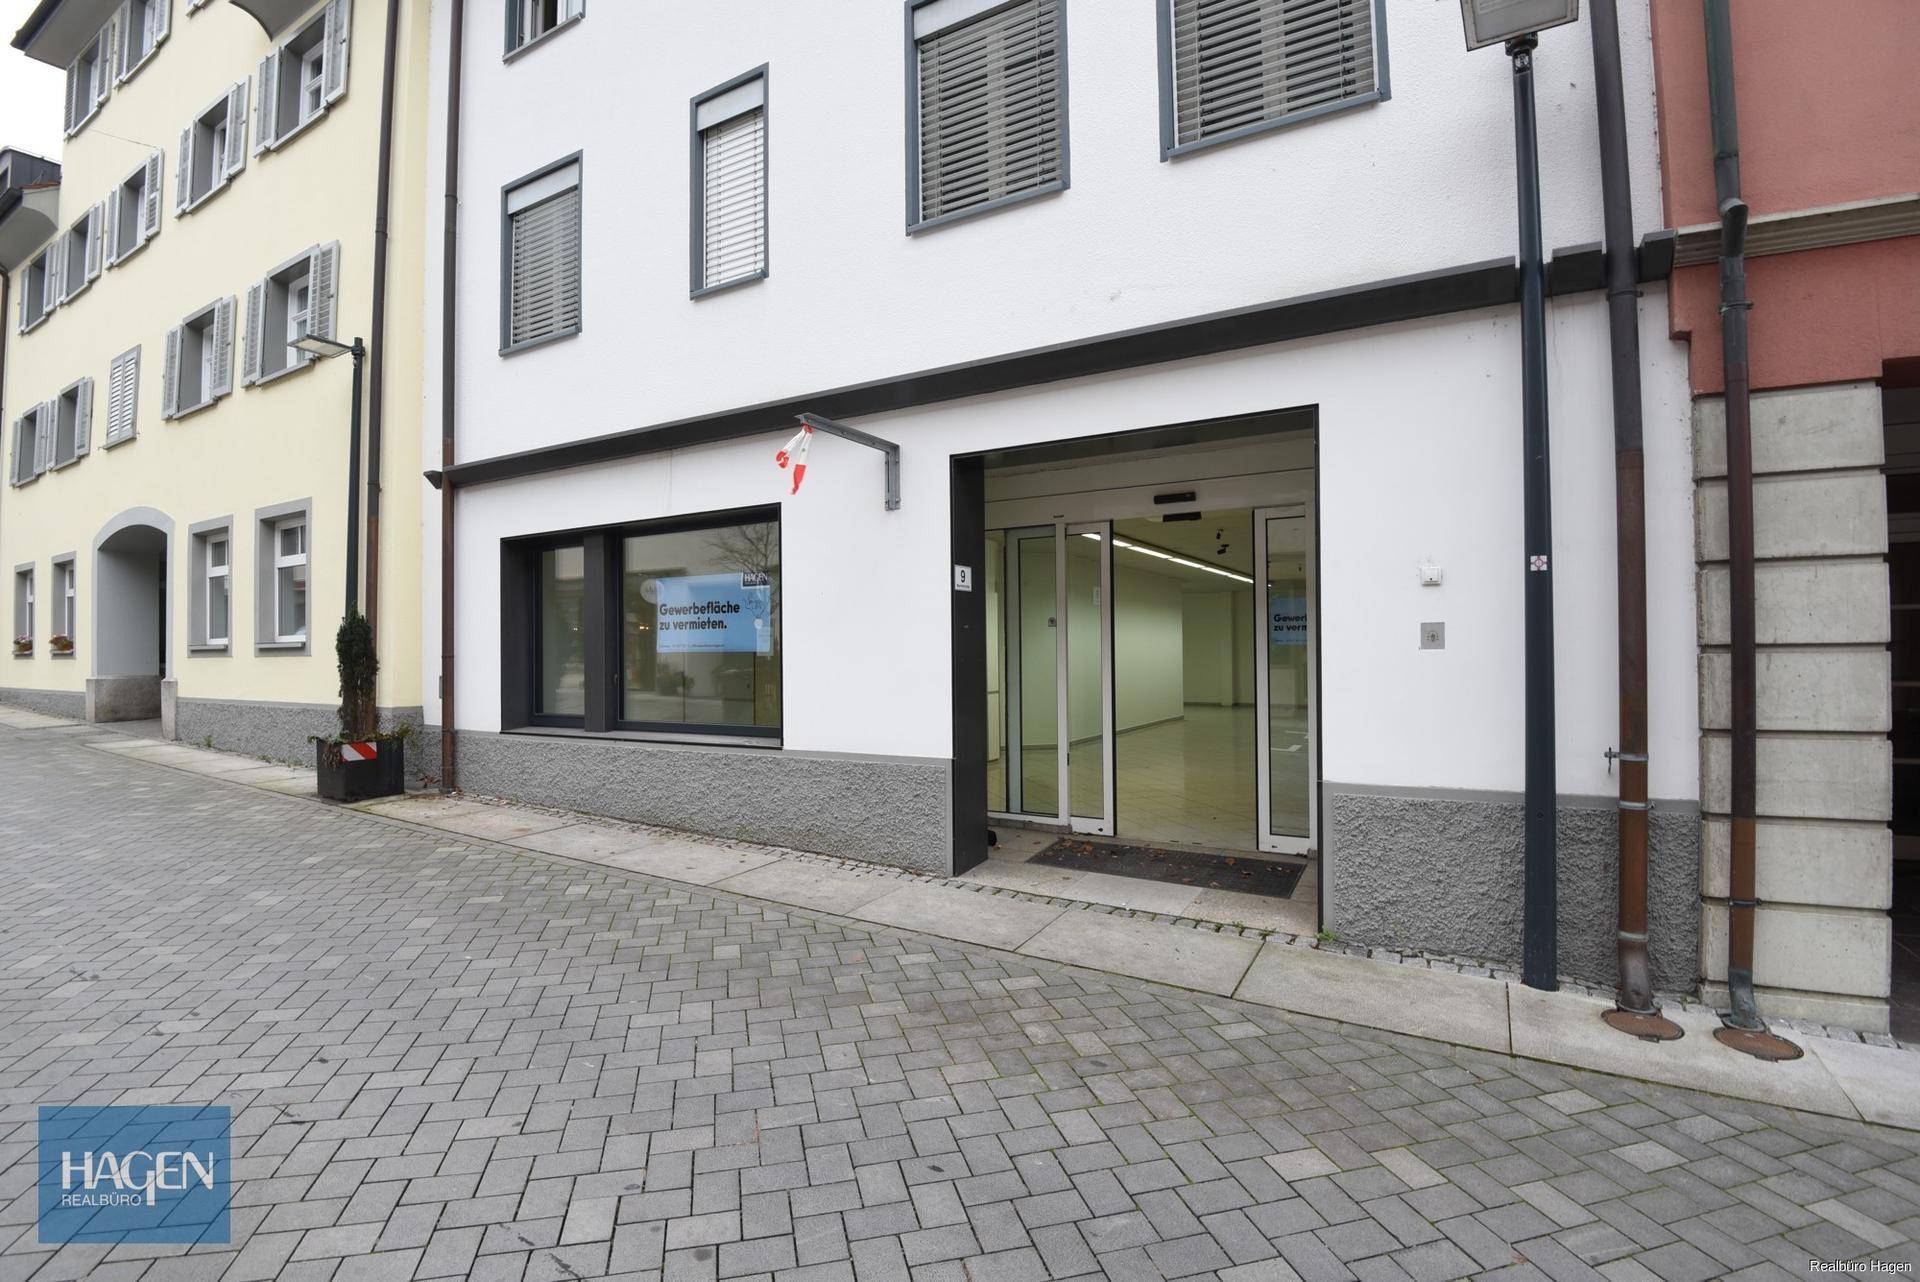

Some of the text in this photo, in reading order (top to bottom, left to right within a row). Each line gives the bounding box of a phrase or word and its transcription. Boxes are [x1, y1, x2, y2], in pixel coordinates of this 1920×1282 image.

[960, 569, 966, 583] 9
[660, 601, 740, 615] Gewerbefläche
[659, 618, 727, 631] zu vermieten.
